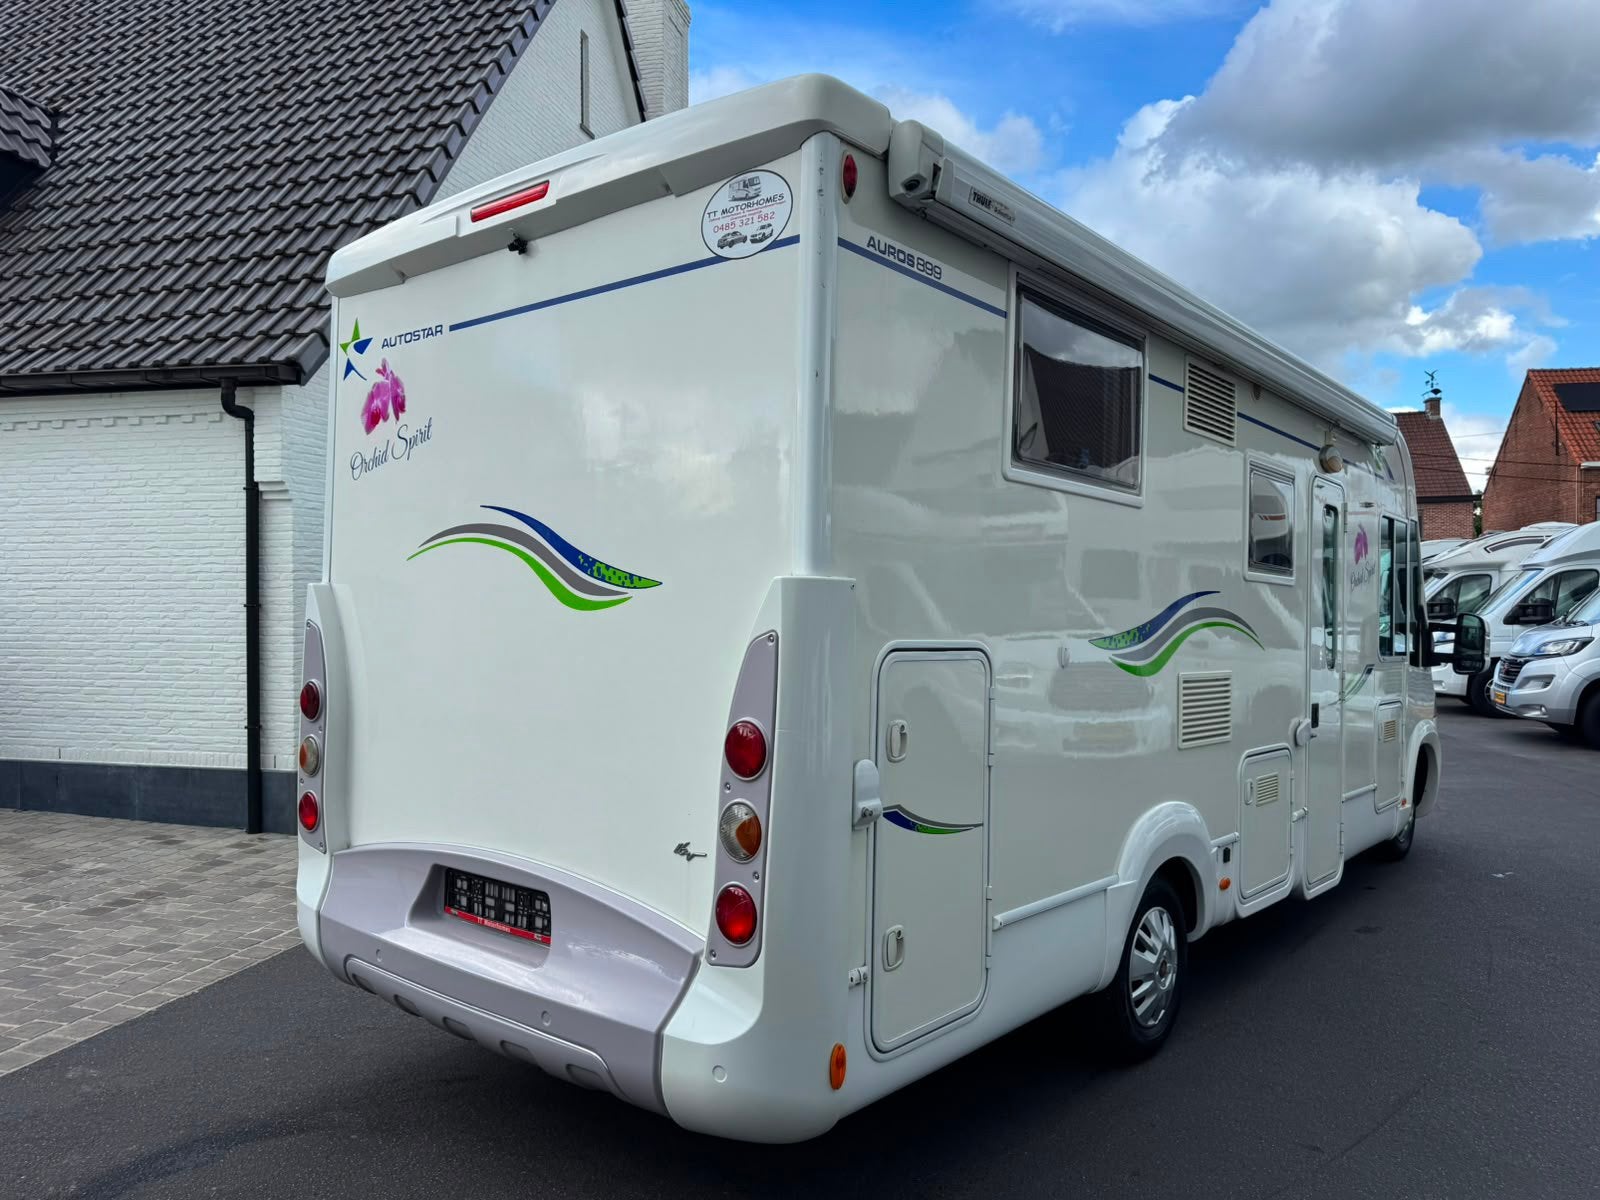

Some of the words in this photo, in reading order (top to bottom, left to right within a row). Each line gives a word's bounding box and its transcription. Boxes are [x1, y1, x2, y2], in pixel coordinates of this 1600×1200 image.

[707, 210, 719, 219] TT
[720, 193, 785, 216] MOTORHOMES
[713, 221, 736, 233] 0485
[738, 217, 754, 228] 321
[757, 211, 775, 223] 582
[381, 324, 443, 349] AUTOSTAR
[350, 439, 390, 481] Orchid
[391, 416, 432, 461] Spirit
